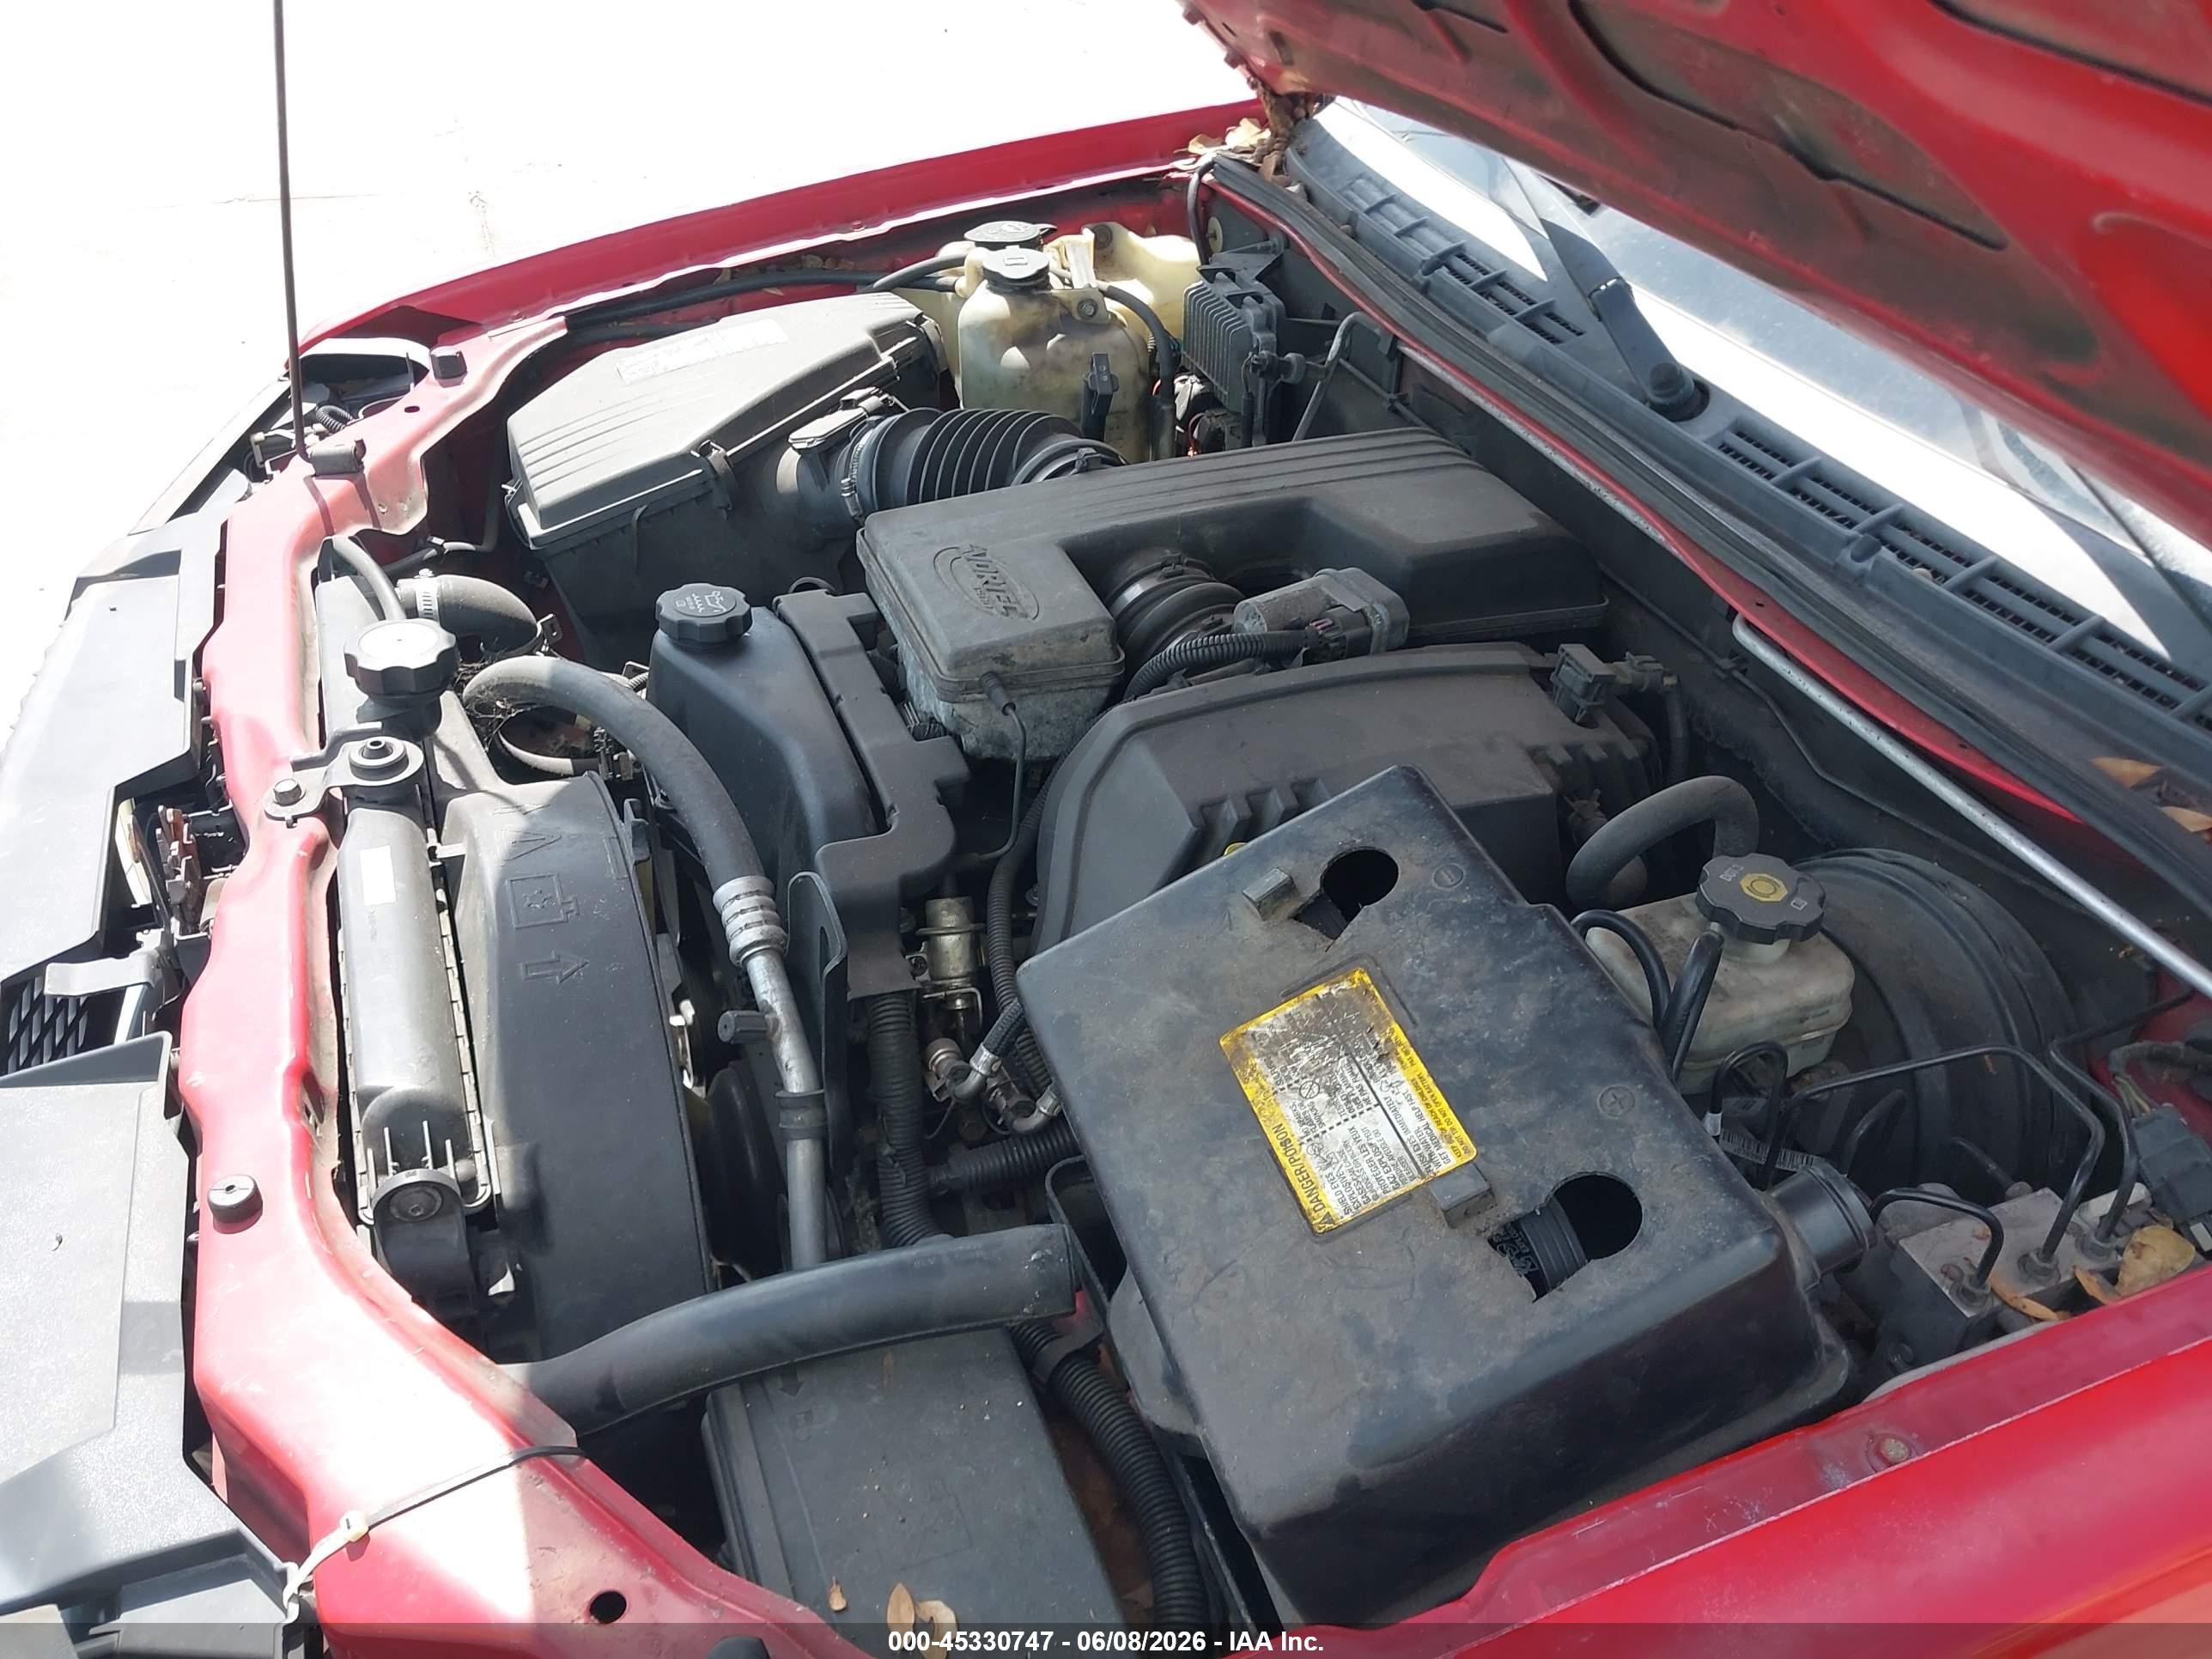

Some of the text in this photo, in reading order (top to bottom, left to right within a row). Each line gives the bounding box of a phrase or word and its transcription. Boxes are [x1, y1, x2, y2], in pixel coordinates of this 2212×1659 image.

[1410, 1104, 1425, 1122] HELP
[1347, 1125, 1363, 1144] YEUX
[1406, 1133, 1421, 1152] EYES
[1420, 1121, 1443, 1151] MEDICAL
[1357, 1142, 1370, 1158] LES
[1437, 1150, 1451, 1165] GET
[1271, 1121, 1326, 1213] DANGER/POISON
[1324, 1171, 1340, 1190] EYES
[1335, 1170, 1362, 1210] EXPLOSIVE
[1386, 1173, 1401, 1190] GAZ
[1352, 1179, 1371, 1205] GASES
